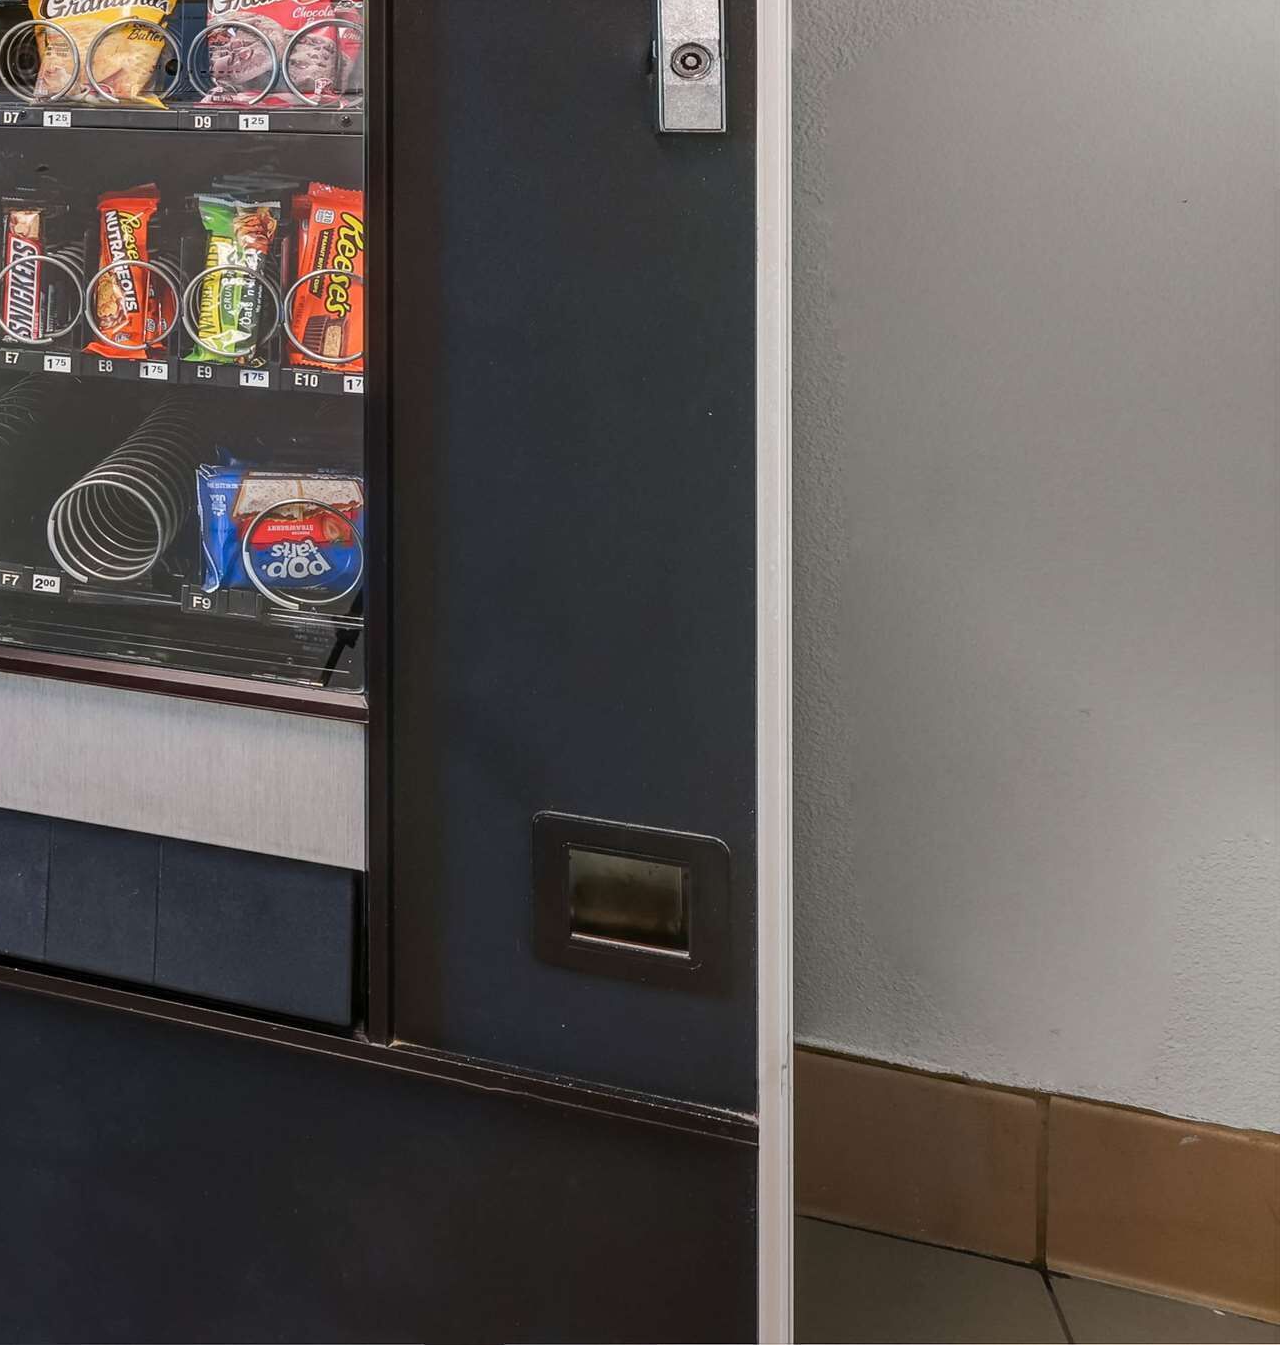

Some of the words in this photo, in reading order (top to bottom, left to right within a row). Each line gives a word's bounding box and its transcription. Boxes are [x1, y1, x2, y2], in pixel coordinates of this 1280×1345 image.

[194, 116, 211, 128] D9
[5, 352, 19, 364] E7
[197, 367, 212, 378] E9
[295, 374, 318, 387] E10
[192, 595, 211, 609] F9
